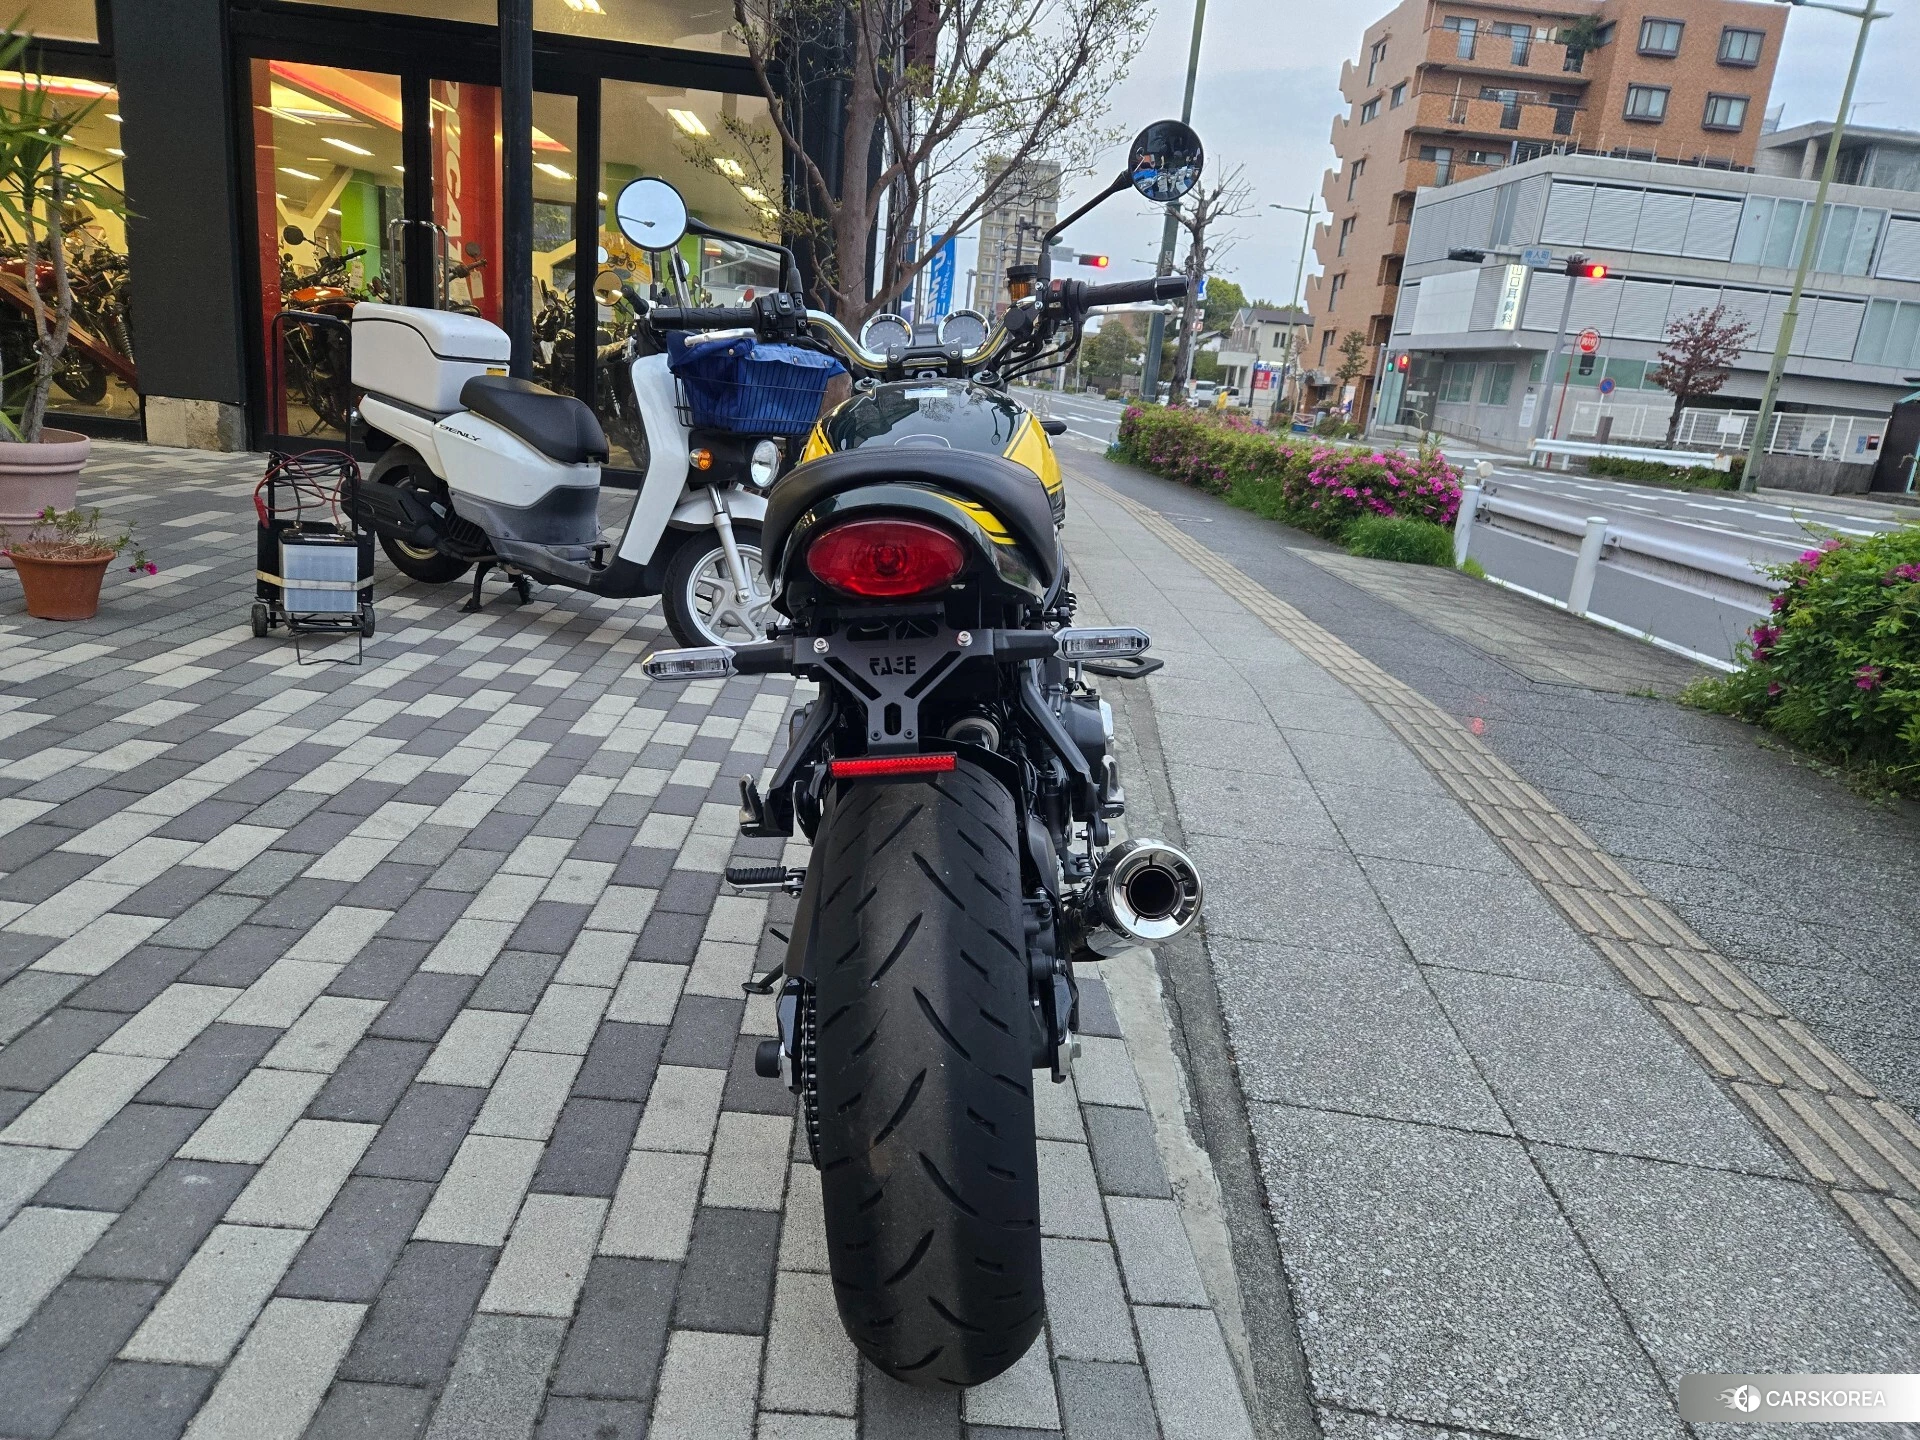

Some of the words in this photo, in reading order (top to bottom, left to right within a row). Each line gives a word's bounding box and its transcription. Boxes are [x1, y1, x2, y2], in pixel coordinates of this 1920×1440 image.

[1501, 265, 1522, 325] 山口耳鼻科
[440, 423, 481, 442] BENLY
